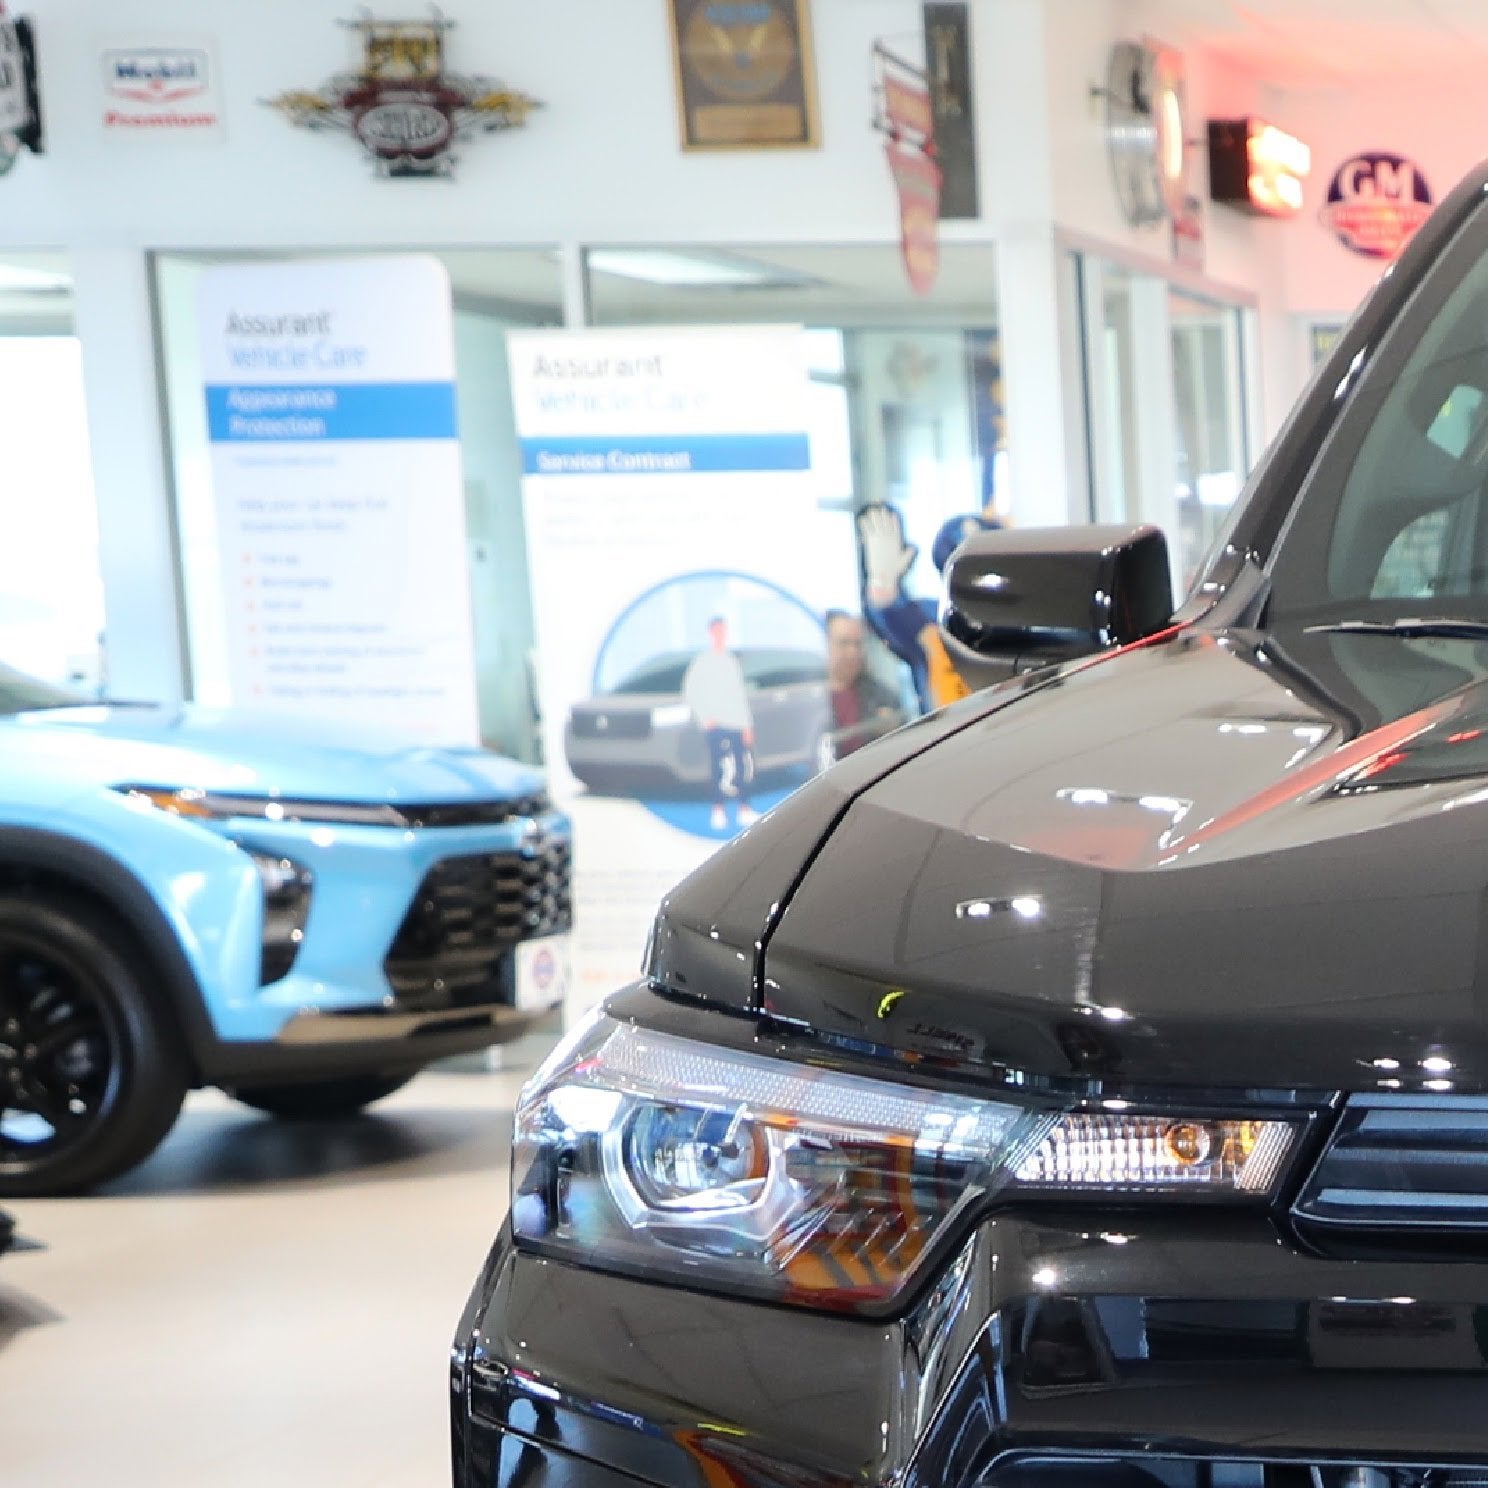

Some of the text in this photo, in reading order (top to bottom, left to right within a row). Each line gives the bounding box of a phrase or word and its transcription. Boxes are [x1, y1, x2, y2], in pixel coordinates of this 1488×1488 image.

[1338, 157, 1415, 204] GM
[225, 311, 332, 336] Assurant
[533, 355, 663, 379] Assurant
[537, 448, 692, 473] Service Contract
